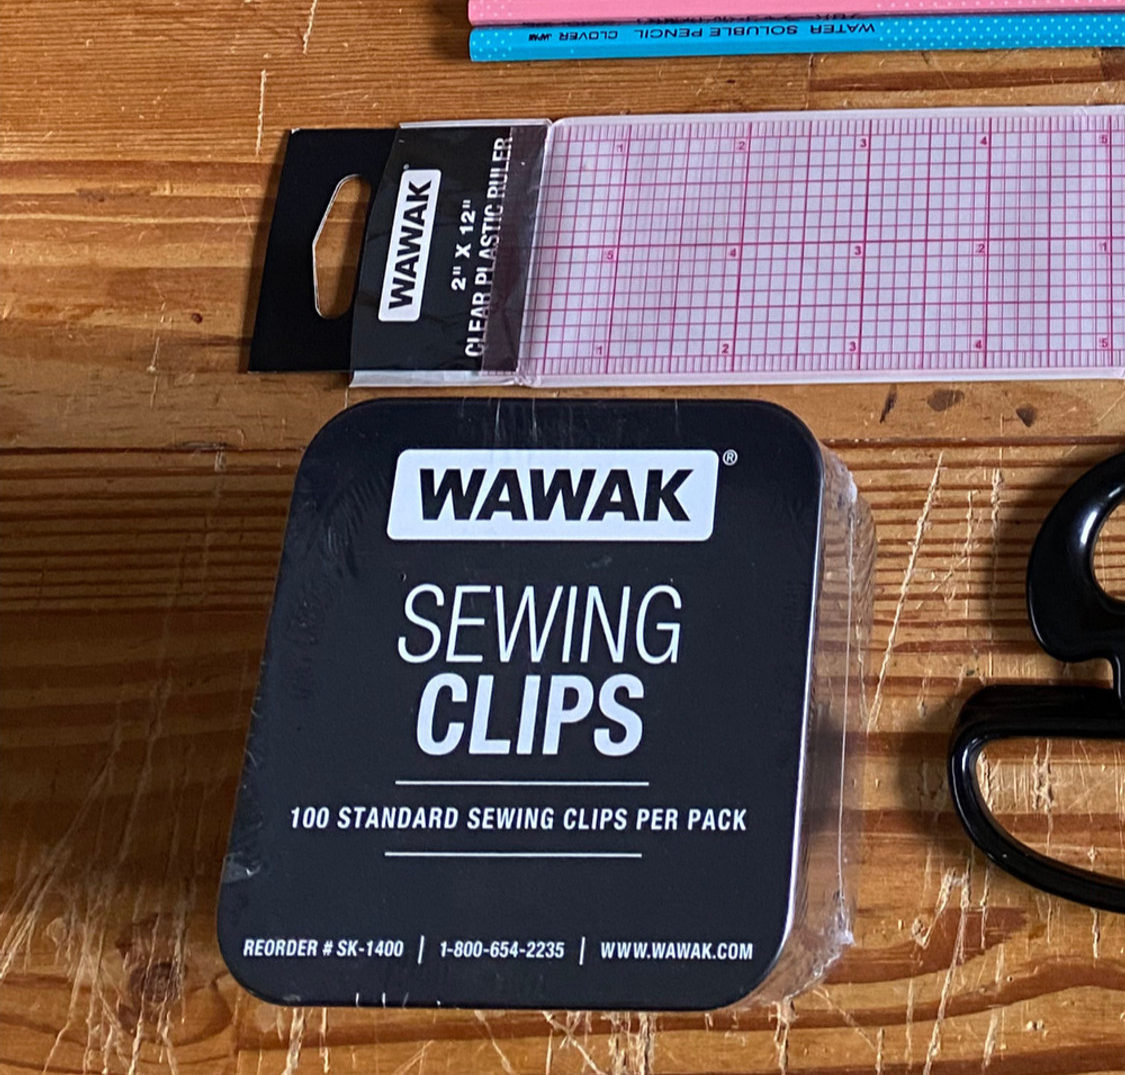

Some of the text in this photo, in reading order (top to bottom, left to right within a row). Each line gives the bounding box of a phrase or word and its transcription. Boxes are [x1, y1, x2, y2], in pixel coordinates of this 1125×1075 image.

[559, 30, 618, 42] CLOVER
[634, 28, 703, 39] PENCIL
[709, 25, 798, 37] SOLUBLE
[810, 23, 875, 35] WATER
[388, 179, 432, 309] WAWAK
[451, 199, 476, 291] 2" X 12"
[464, 136, 514, 357] CLEAR PLASTIC RULER
[420, 469, 694, 522] WAWAK
[398, 584, 683, 664] SEWING
[417, 673, 645, 756] CLIPS
[291, 806, 747, 831] 100 STANDARD SEWING CLIPS PER PACK
[243, 938, 318, 957] REORDER
[336, 939, 404, 957] SK-1400
[440, 941, 565, 959] 1-800-654-2235
[600, 942, 753, 960] WWW.WAWAK.COM
